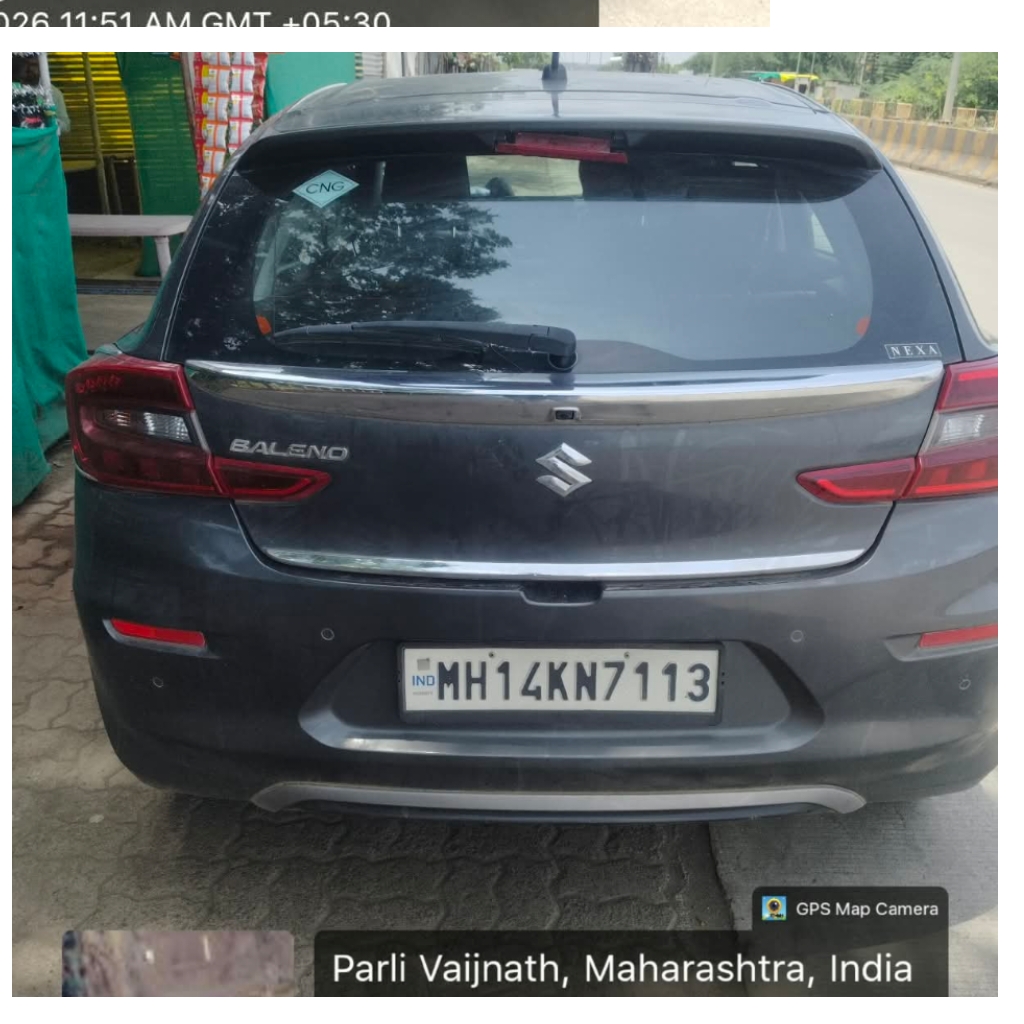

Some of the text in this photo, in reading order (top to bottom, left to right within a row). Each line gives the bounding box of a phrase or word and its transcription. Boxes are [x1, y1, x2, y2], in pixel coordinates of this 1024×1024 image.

[306, 181, 345, 194] CNG
[889, 345, 938, 356] NEXA
[229, 438, 350, 462] BALENO
[412, 660, 711, 703] IND MH14KN7113
